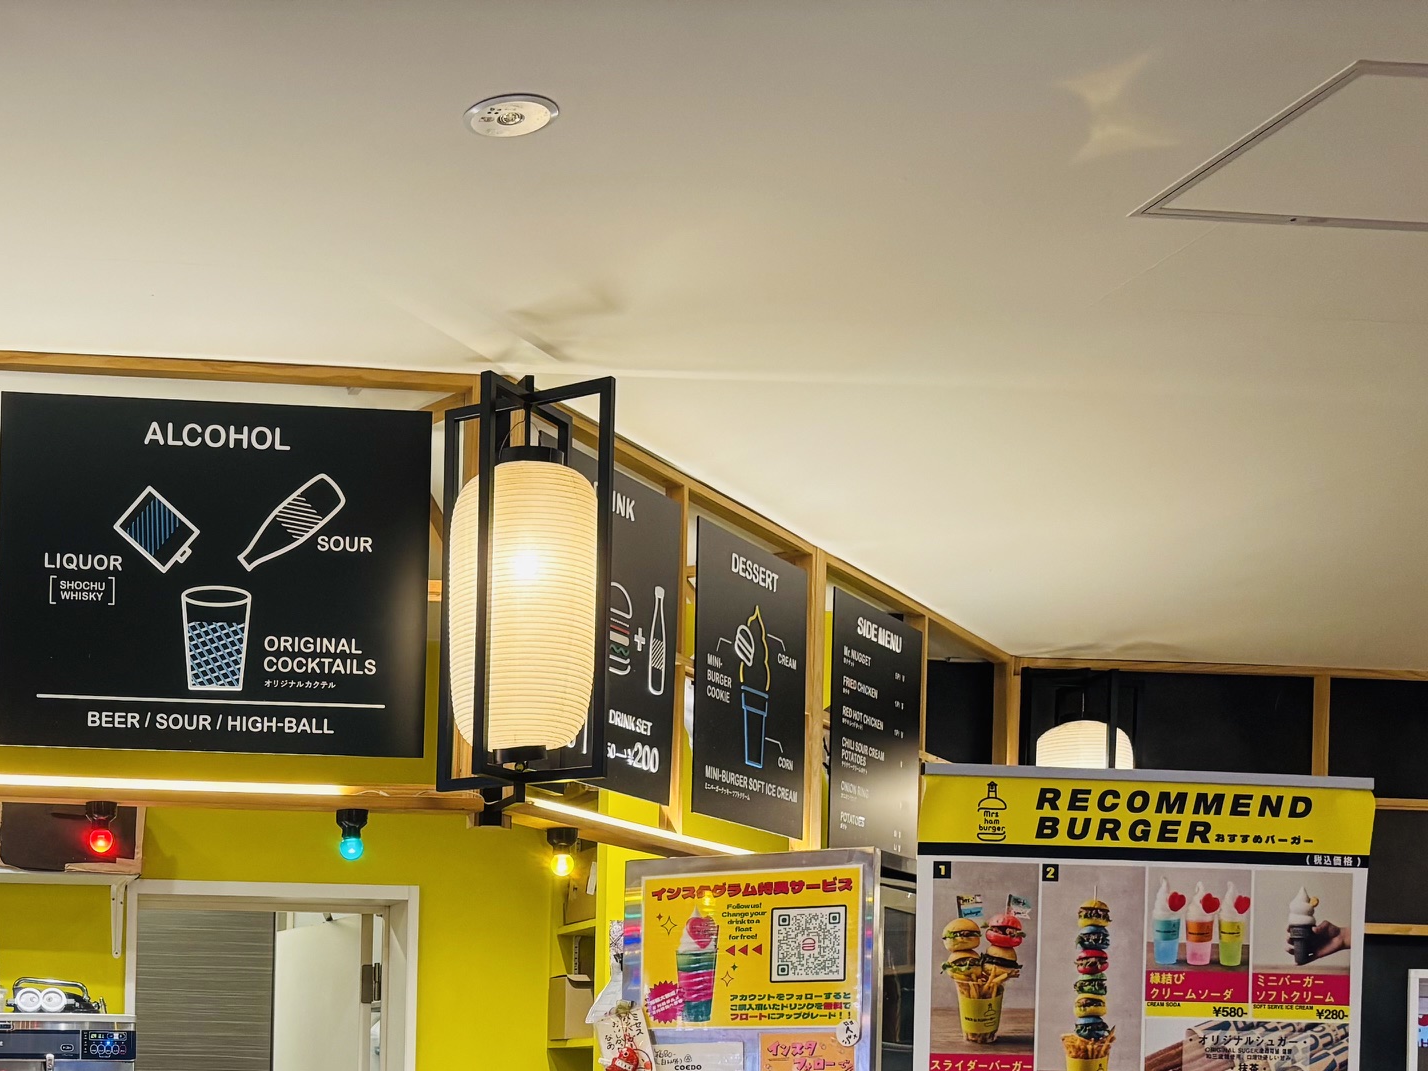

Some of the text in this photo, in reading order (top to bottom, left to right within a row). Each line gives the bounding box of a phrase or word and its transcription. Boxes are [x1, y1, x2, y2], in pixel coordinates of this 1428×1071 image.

[143, 421, 291, 451] ALCOHOL
[317, 535, 373, 554] SOUR
[44, 552, 123, 572] LIQUOR
[731, 552, 779, 593] DESSERT
[59, 580, 106, 591] SHOCHU
[60, 590, 104, 602] WHISKY
[857, 616, 902, 654] SIDE MENU
[264, 636, 362, 655] ORIGINAL
[263, 657, 377, 676] COCKTAILS
[777, 652, 797, 671] CREAM
[264, 679, 336, 690] オリジナルカクテル
[707, 668, 732, 689] BURGER
[706, 685, 730, 703] COOKIE
[87, 711, 334, 735] BEER SOUR HIGH-BALL
[608, 708, 653, 736] DRINK SET
[778, 756, 794, 772] CORN
[705, 765, 798, 803] MINI-BURGER SOFT ICE CREAM
[1035, 787, 1314, 819] RECOMMEND
[1035, 817, 1213, 845] BURGER
[1214, 832, 1314, 845] おすすめバーガー
[1150, 988, 1233, 1000] クリームソーダ
[1257, 990, 1335, 1003] ソフトクリーム
[1213, 1006, 1248, 1017] ¥580-
[1316, 1009, 1348, 1020] ¥280-
[930, 1060, 1033, 1071] スライダーバーガー
